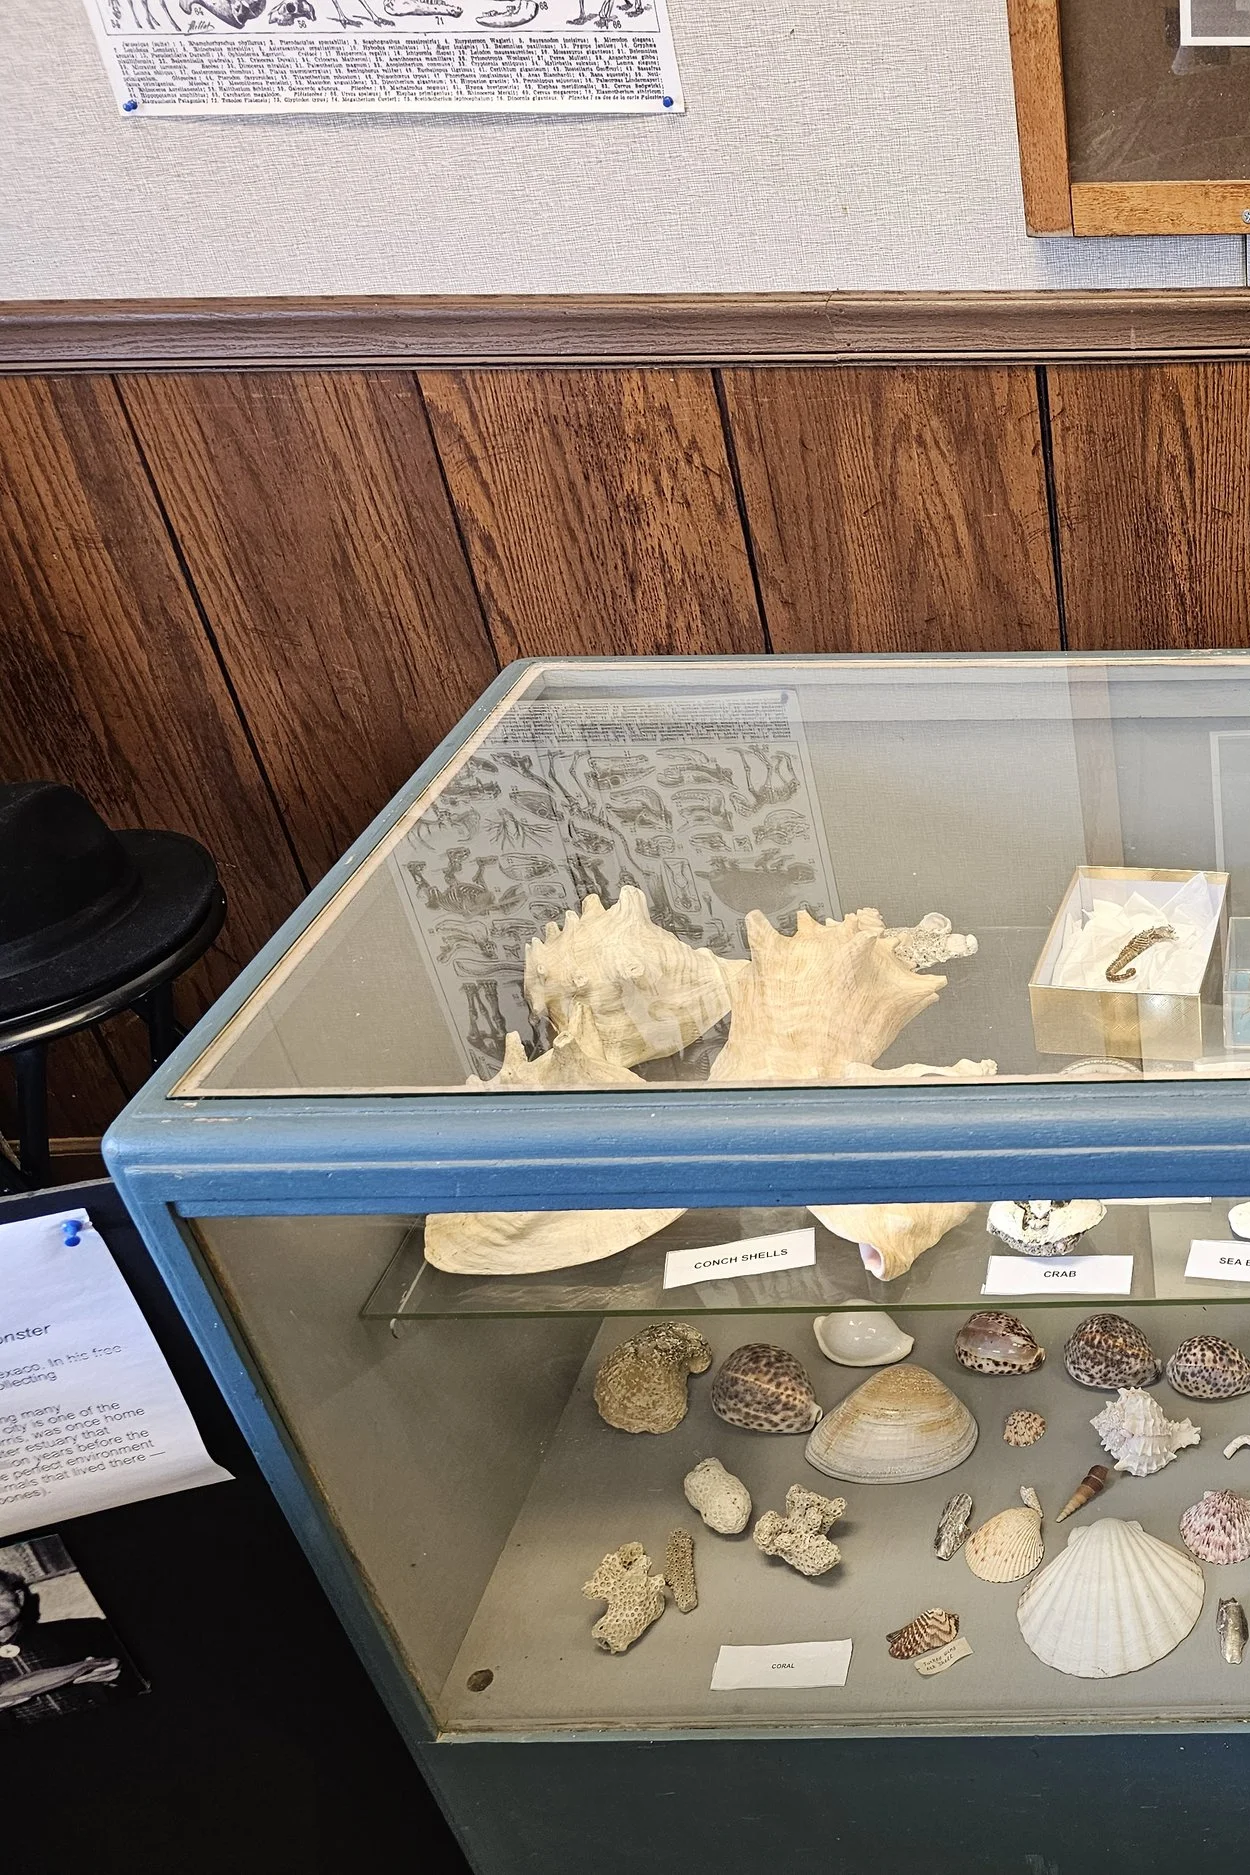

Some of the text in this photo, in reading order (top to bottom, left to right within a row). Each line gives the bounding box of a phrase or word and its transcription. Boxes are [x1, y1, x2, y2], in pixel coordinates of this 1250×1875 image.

[694, 1248, 788, 1270] CONCH SHELLS
[1219, 1257, 1242, 1266] SEA
[1043, 1270, 1077, 1278] CRAB
[2, 1401, 121, 1435] city is one of the
[20, 1403, 61, 1419] many
[32, 1426, 62, 1440] was
[65, 1417, 101, 1432] once
[104, 1407, 145, 1423] home
[25, 1433, 78, 1453] estuary
[82, 1426, 111, 1440] that
[37, 1448, 74, 1467] years
[77, 1435, 123, 1452] before
[126, 1428, 150, 1441] the
[13, 1458, 63, 1481] perfect
[66, 1438, 155, 1467] environment
[41, 1470, 70, 1484] that
[72, 1461, 106, 1477] lived
[109, 1453, 147, 1469] there
[771, 1662, 795, 1670] CORAL
